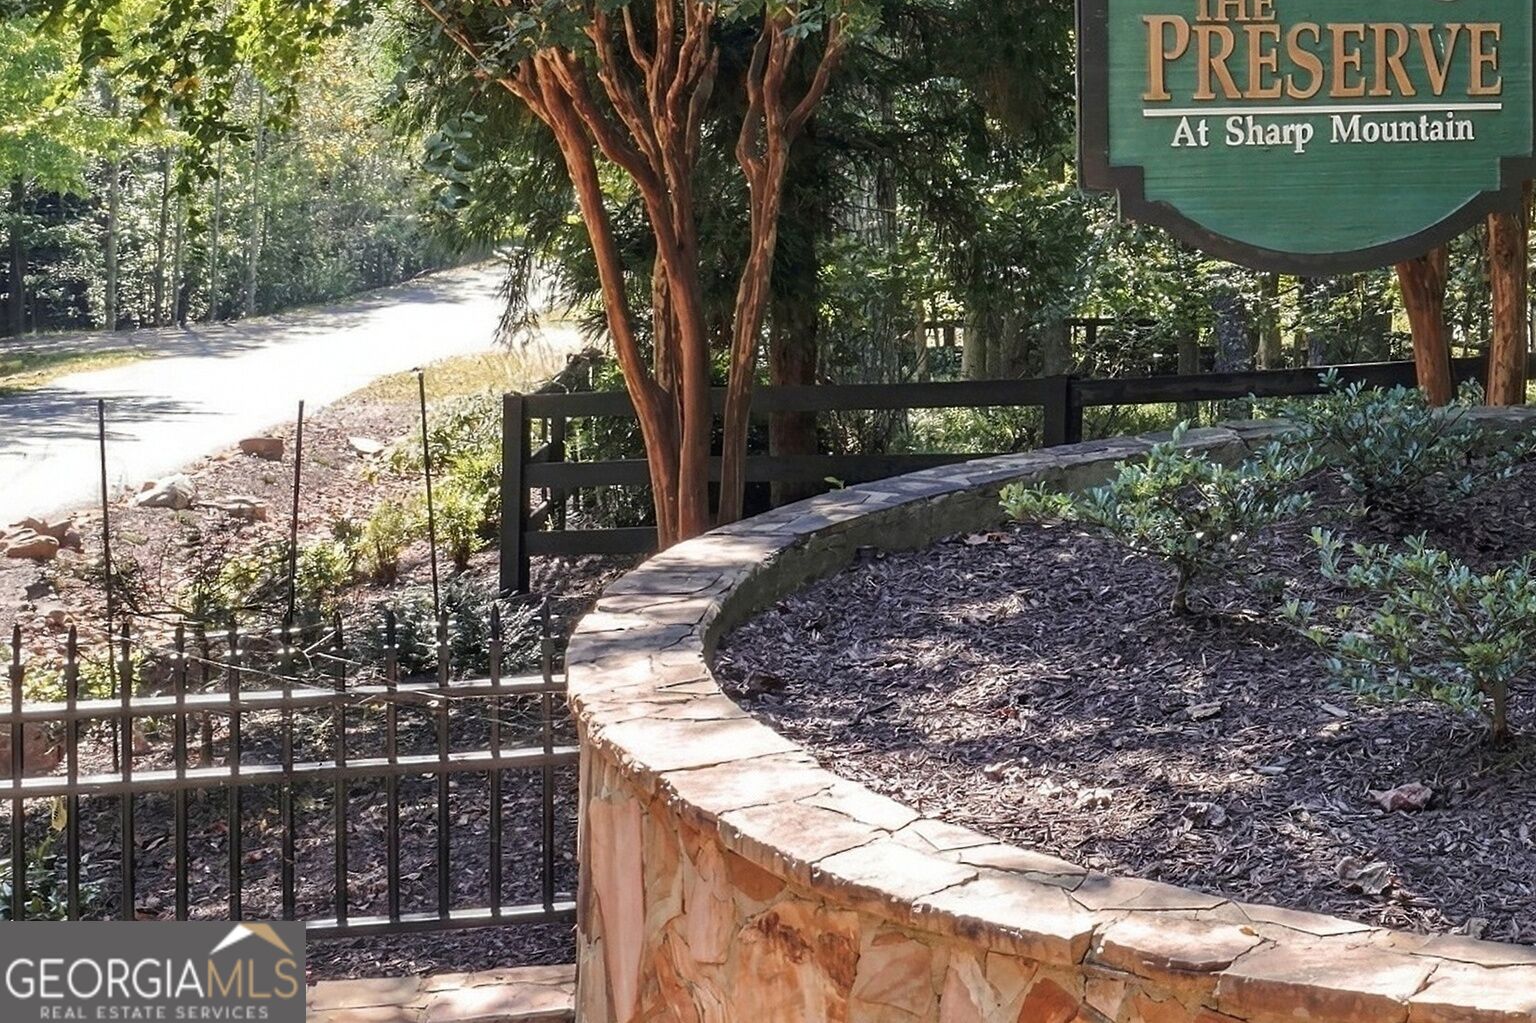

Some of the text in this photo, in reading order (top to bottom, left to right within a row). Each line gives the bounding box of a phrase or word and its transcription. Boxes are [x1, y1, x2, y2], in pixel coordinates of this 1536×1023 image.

[1143, 14, 1502, 101] PRESERVE
[1171, 111, 1475, 153] At Sharp Mountain
